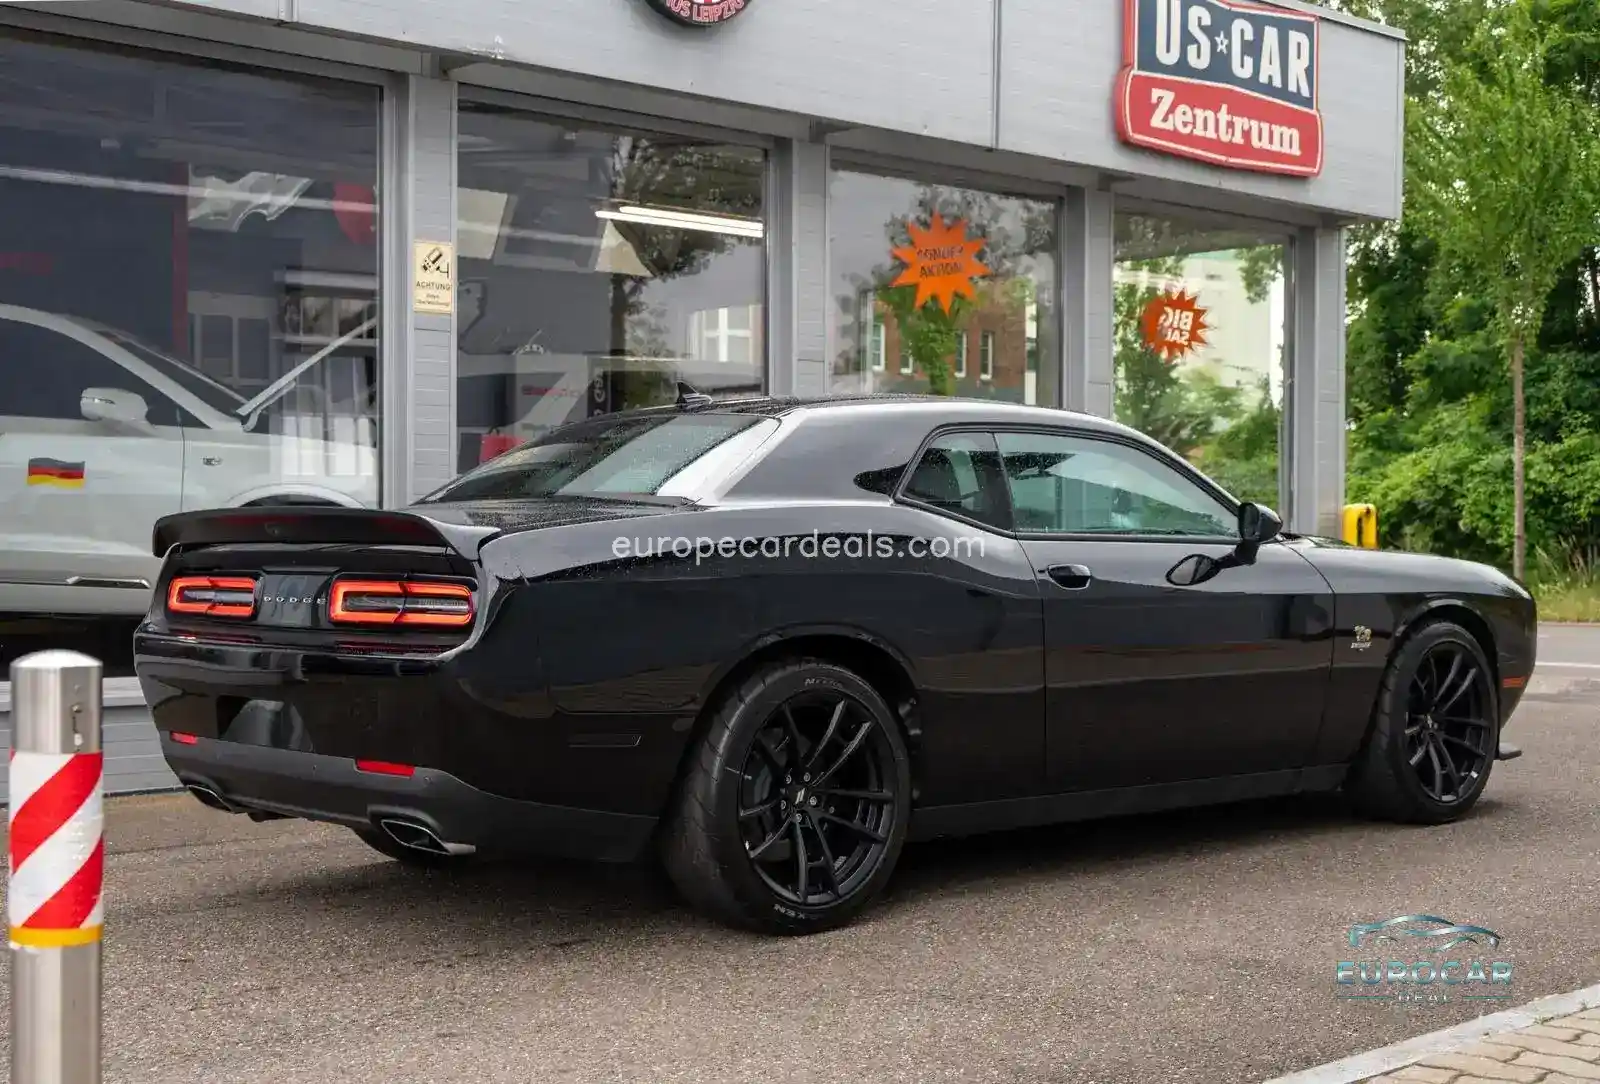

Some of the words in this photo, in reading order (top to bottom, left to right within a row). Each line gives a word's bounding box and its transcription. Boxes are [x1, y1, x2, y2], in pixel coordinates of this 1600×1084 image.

[1150, 88, 1301, 156] Zentrum
[416, 280, 451, 291] ACHTUNG
[263, 596, 326, 605] DODGE
